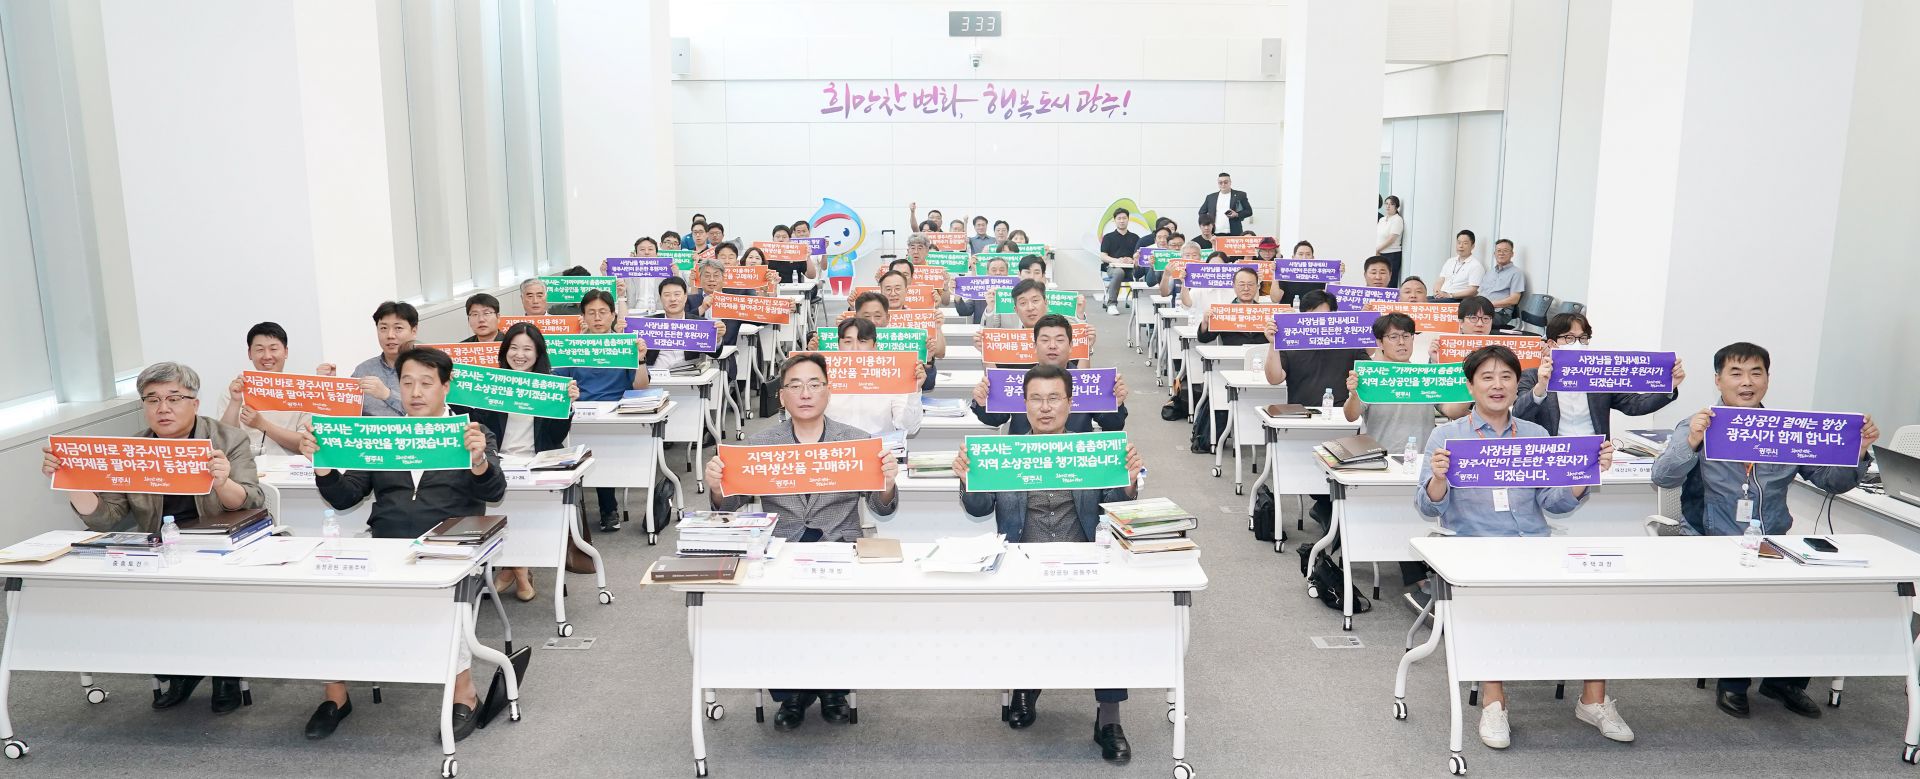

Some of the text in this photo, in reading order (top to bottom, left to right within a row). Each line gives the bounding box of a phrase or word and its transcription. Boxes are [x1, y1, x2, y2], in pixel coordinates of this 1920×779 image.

[821, 81, 907, 117] 희망찬
[1076, 83, 1132, 118] 광주!
[1297, 316, 1359, 326] 사장님들 힘내세요!
[820, 332, 838, 340] 광주
[1284, 327, 1372, 336] 광주시민이 든든한 후원자가
[544, 338, 564, 347] 주시는
[1308, 336, 1347, 346] 되겠습니다.
[1441, 340, 1465, 348] 지금이
[486, 346, 500, 354] 모두
[856, 356, 896, 366] 이용하기
[1578, 355, 1650, 365] 사장님들 힘내세요!
[828, 367, 901, 379] 생산품 구매하기
[1358, 366, 1390, 376] 광주시는
[1438, 366, 1464, 374] 촘촘하
[1561, 366, 1664, 376] 광주시민이 든든한 후원자가
[274, 377, 294, 388] 바로
[296, 379, 334, 390] 광주시민
[452, 368, 484, 382] 광주시는
[532, 379, 567, 392] 촘촘하게!
[1006, 374, 1101, 384] 소상 항상
[1362, 376, 1420, 388] 지역 소상공인을
[1590, 378, 1633, 388] 되겠습니다.
[456, 380, 472, 390] 지역
[474, 384, 514, 396] 소상공인을
[1004, 385, 1024, 396] 광주
[248, 387, 363, 405] 지역제품 팔아주기 동참할때
[313, 422, 352, 435] 광주시는
[1730, 414, 1848, 431] 소상공인 곁에는 항상
[322, 436, 461, 450] 지역 소상공인을 챙기겠습니다.
[1726, 428, 1846, 446] 광주시가 함께 합니다.
[54, 442, 211, 460] 지금이 바로 광주시민 모두가
[970, 438, 1127, 455] 광주시는 "가까이에서 촘촘하게!"
[1480, 442, 1570, 456] 사장님들 힘내세요!
[748, 446, 856, 463] 지역상가 이용하기
[1458, 454, 1588, 468] 광주시민이 든든한 후원자가
[60, 456, 108, 470] 지역제품
[111, 458, 160, 472] 팔아주기
[742, 460, 864, 476] 지역생산품 구매하기
[978, 454, 1122, 470] 지역 소상공인을 챙기겠습니다.
[1494, 469, 1550, 482] 되겠습니다.
